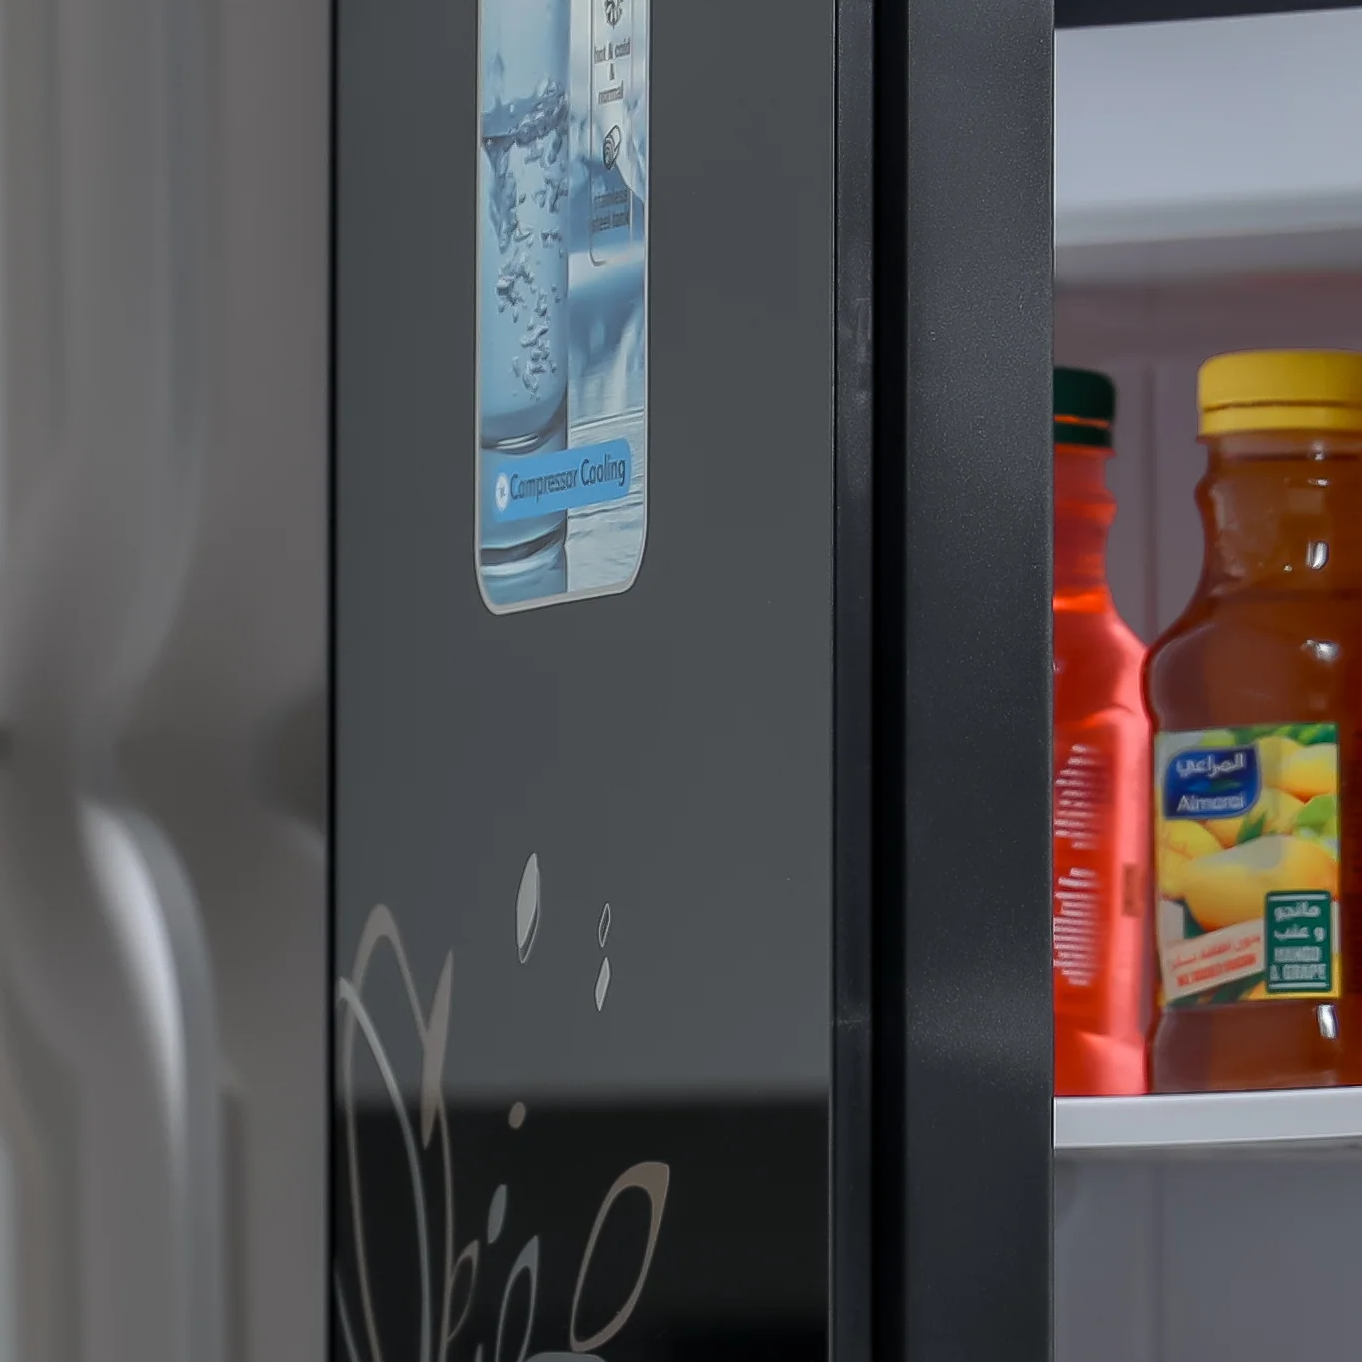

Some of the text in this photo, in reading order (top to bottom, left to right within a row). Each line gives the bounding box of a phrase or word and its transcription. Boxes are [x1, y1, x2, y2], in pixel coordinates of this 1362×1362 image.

[510, 453, 626, 503] Compressor Cooling
[1175, 751, 1247, 779] المراعي
[1176, 792, 1246, 813] Almarai
